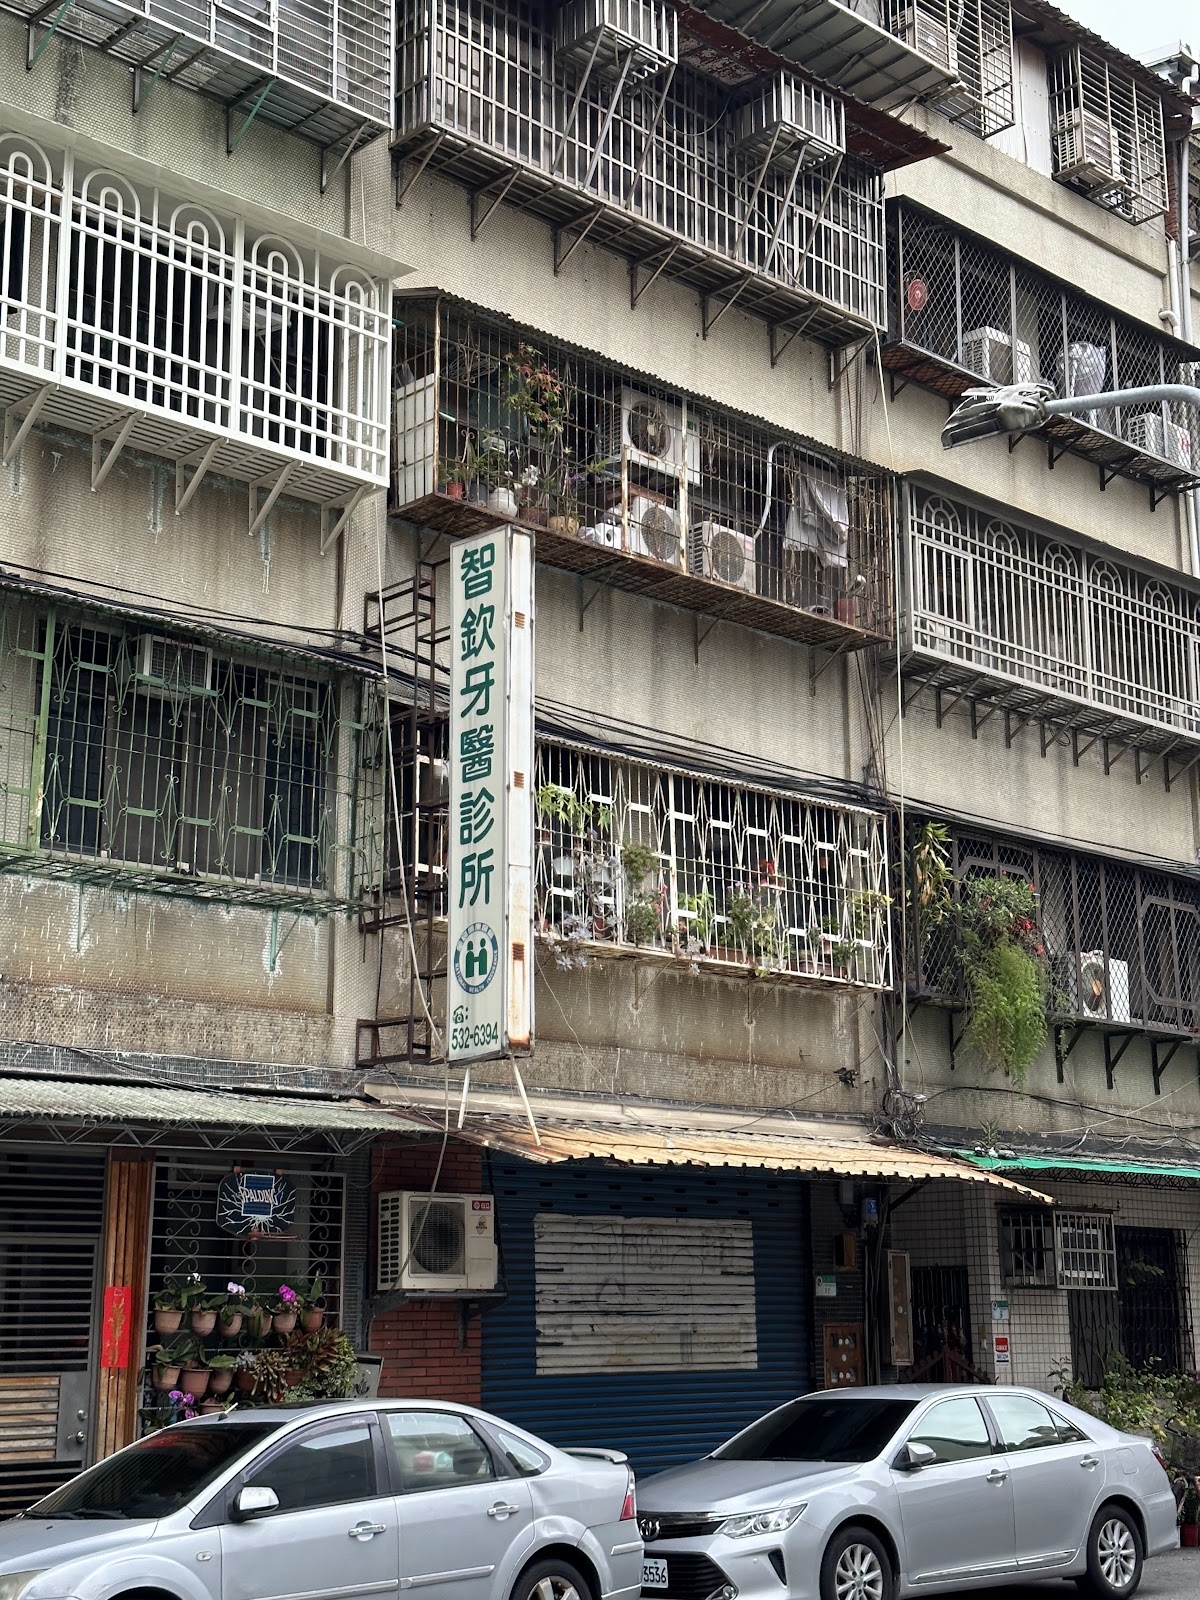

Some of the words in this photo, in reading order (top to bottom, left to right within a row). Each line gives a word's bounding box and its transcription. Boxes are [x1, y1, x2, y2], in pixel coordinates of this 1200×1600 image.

[458, 542, 495, 909] 智欽牙醫診所
[451, 1021, 499, 1051] 532-6394
[239, 1186, 279, 1206] SPALDING
[643, 1566, 667, 1583] 3536
